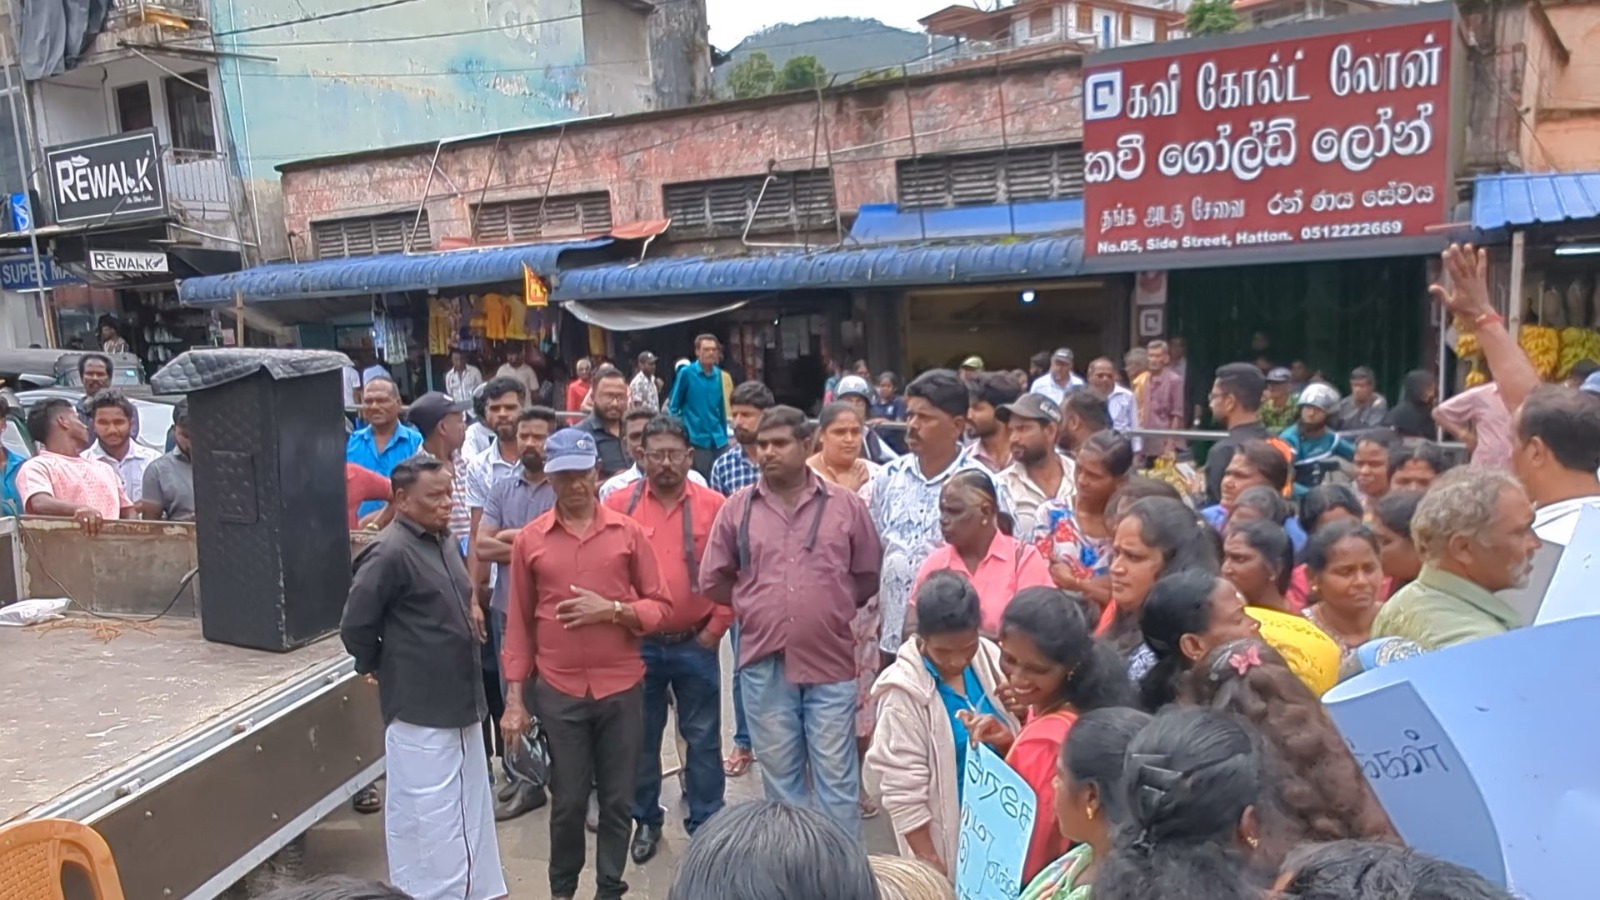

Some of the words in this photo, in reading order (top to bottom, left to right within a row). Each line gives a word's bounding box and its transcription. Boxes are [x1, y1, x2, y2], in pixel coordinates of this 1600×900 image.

[1126, 62, 1180, 119] கவி
[1197, 50, 1310, 111] கோல்ட்
[1330, 33, 1442, 96] லோன்
[1158, 118, 1296, 180] ගෝල්ඩ්
[1312, 103, 1433, 171] ලෝන්
[56, 157, 153, 204] REWALK
[1267, 190, 1303, 215] රන්
[1362, 181, 1434, 207] සේවය
[1100, 202, 1137, 234] தங்க
[1143, 204, 1185, 228] அடகு
[1191, 196, 1245, 221] சேவை
[1097, 239, 1143, 254] No.05,
[1146, 237, 1178, 250] Side
[1182, 234, 1232, 248] Street,
[1236, 229, 1293, 244] Hatton.
[1301, 220, 1402, 240] 0512222669
[2, 261, 48, 284] SUPER
[50, 259, 77, 281] MA
[93, 252, 154, 270] REWALK
